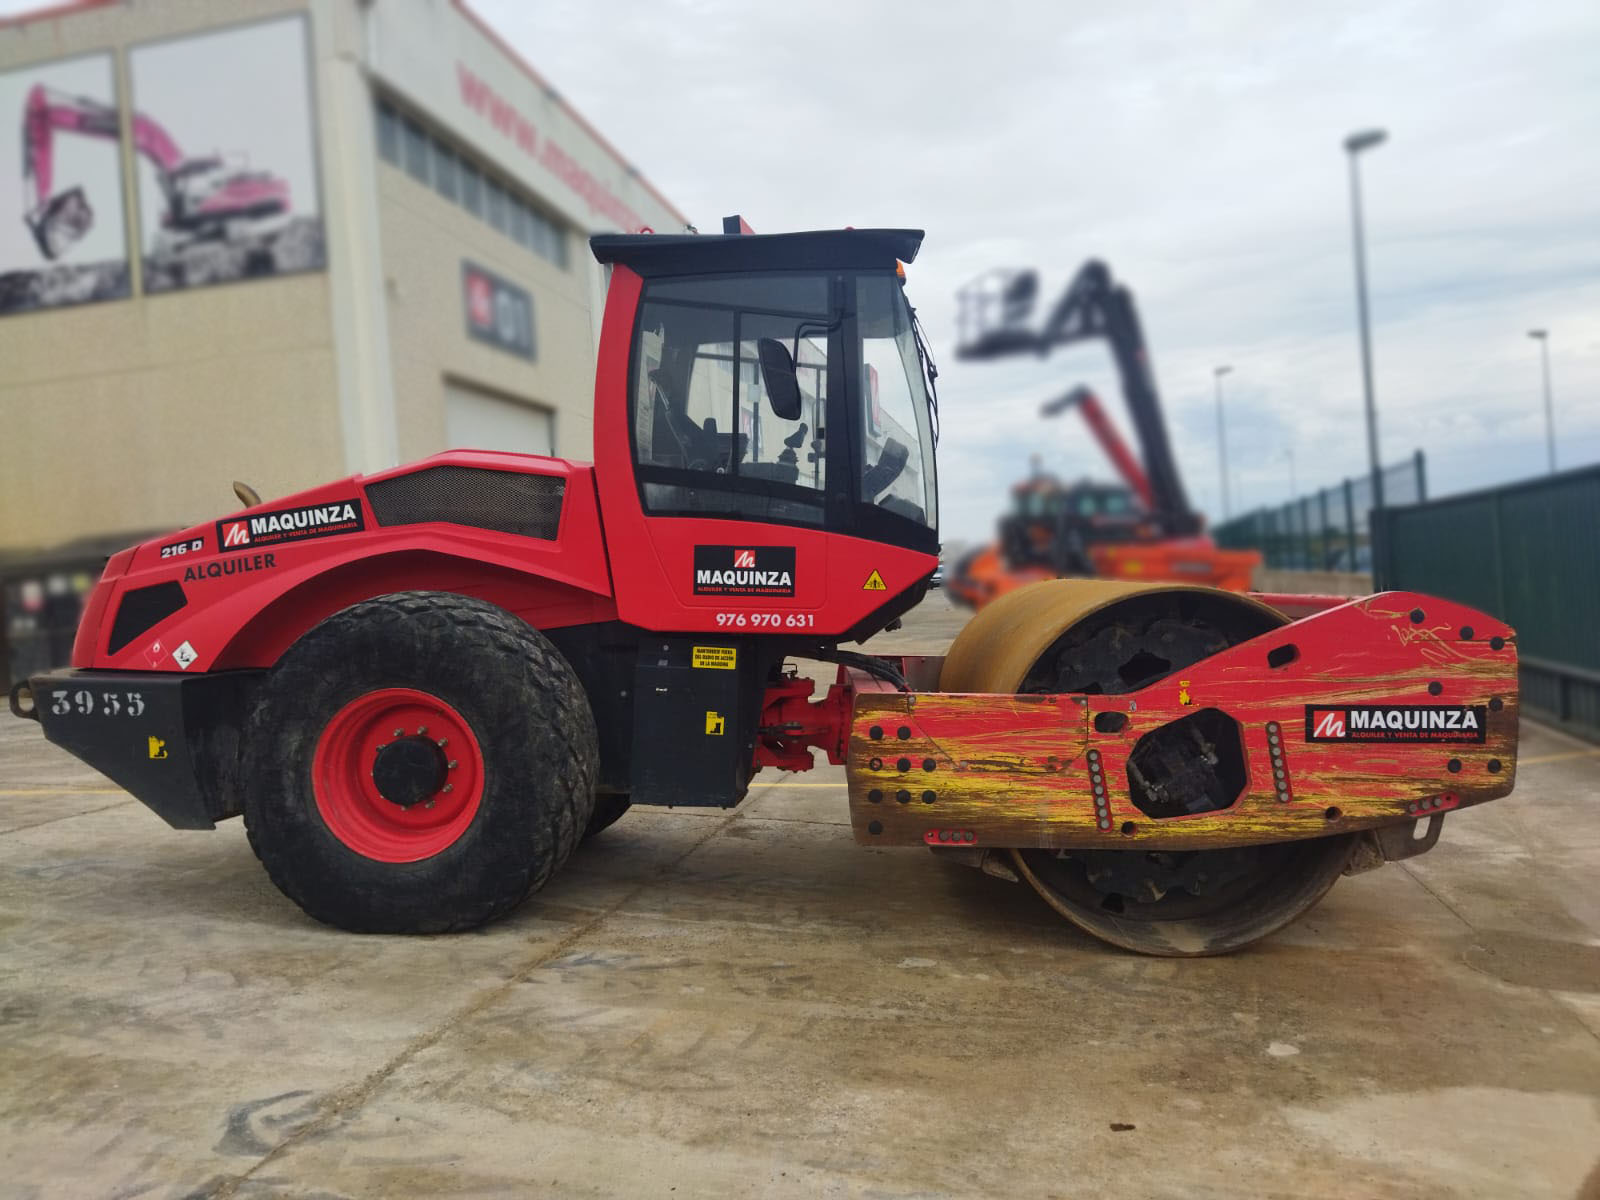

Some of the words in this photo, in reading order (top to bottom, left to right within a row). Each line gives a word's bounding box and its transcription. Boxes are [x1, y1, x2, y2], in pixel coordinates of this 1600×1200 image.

[251, 504, 357, 535] MAQUINZA
[161, 543, 187, 559] 216
[191, 540, 203, 552] D
[183, 553, 277, 582] ALQUILER
[697, 569, 792, 586] MAQUINZA
[716, 613, 747, 627] 976
[750, 613, 782, 627] 970
[785, 614, 814, 628] 631
[52, 690, 145, 716] 3955
[1350, 710, 1479, 730] MAQUINZA
[1352, 731, 1386, 739] ALQUILER
[1387, 731, 1392, 739] Y
[1394, 731, 1418, 739] VENTA
[1419, 731, 1429, 739] DE
